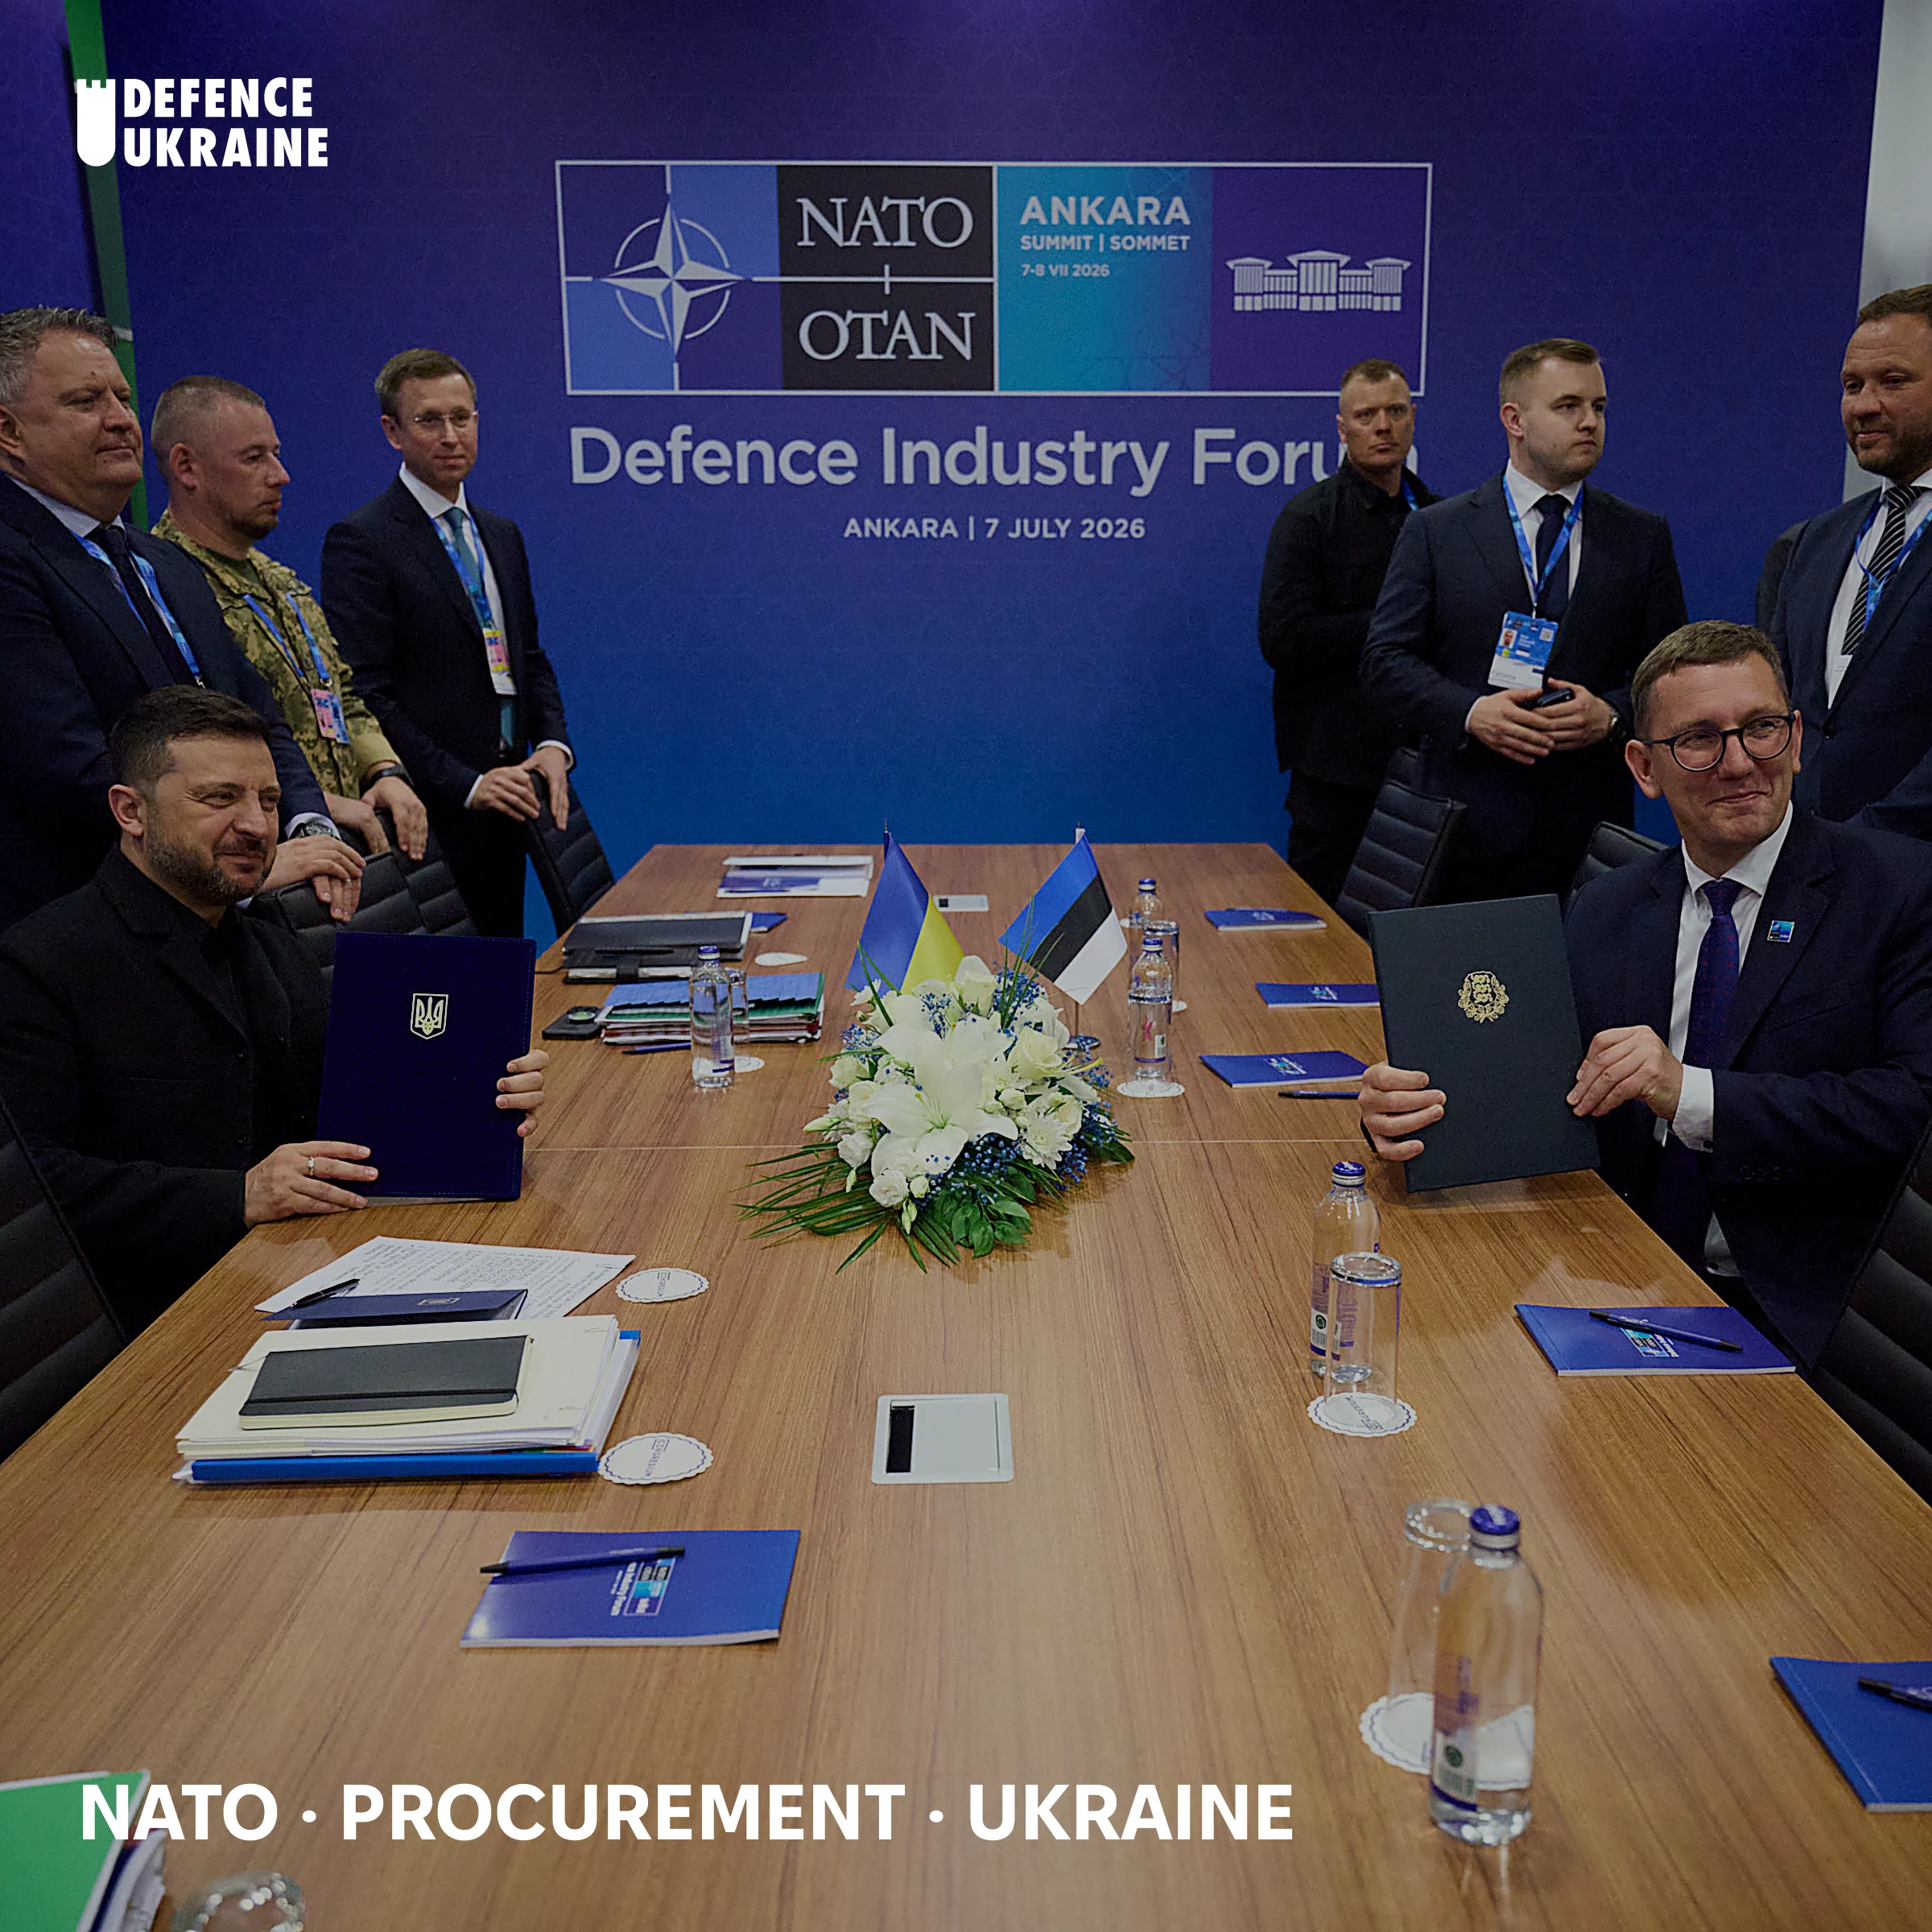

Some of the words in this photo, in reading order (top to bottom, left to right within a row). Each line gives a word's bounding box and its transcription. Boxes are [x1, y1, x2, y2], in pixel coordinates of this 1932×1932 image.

[796, 196, 974, 249] NATO
[1020, 196, 1191, 225] ANKARA
[1020, 233, 1094, 252] SUMMIT
[1110, 234, 1191, 252] SOMMET
[1021, 262, 1045, 277] 7-8
[1048, 263, 1068, 277] VII
[1072, 263, 1111, 278] 2026
[799, 309, 976, 361] OTAN
[570, 424, 858, 485] Defence
[883, 425, 1170, 497] Industry
[1193, 427, 1418, 485] Foru
[844, 518, 958, 540] ANKARA
[985, 518, 1000, 539] 7
[1008, 518, 1072, 539] JULY
[1080, 518, 1146, 539] 2026
